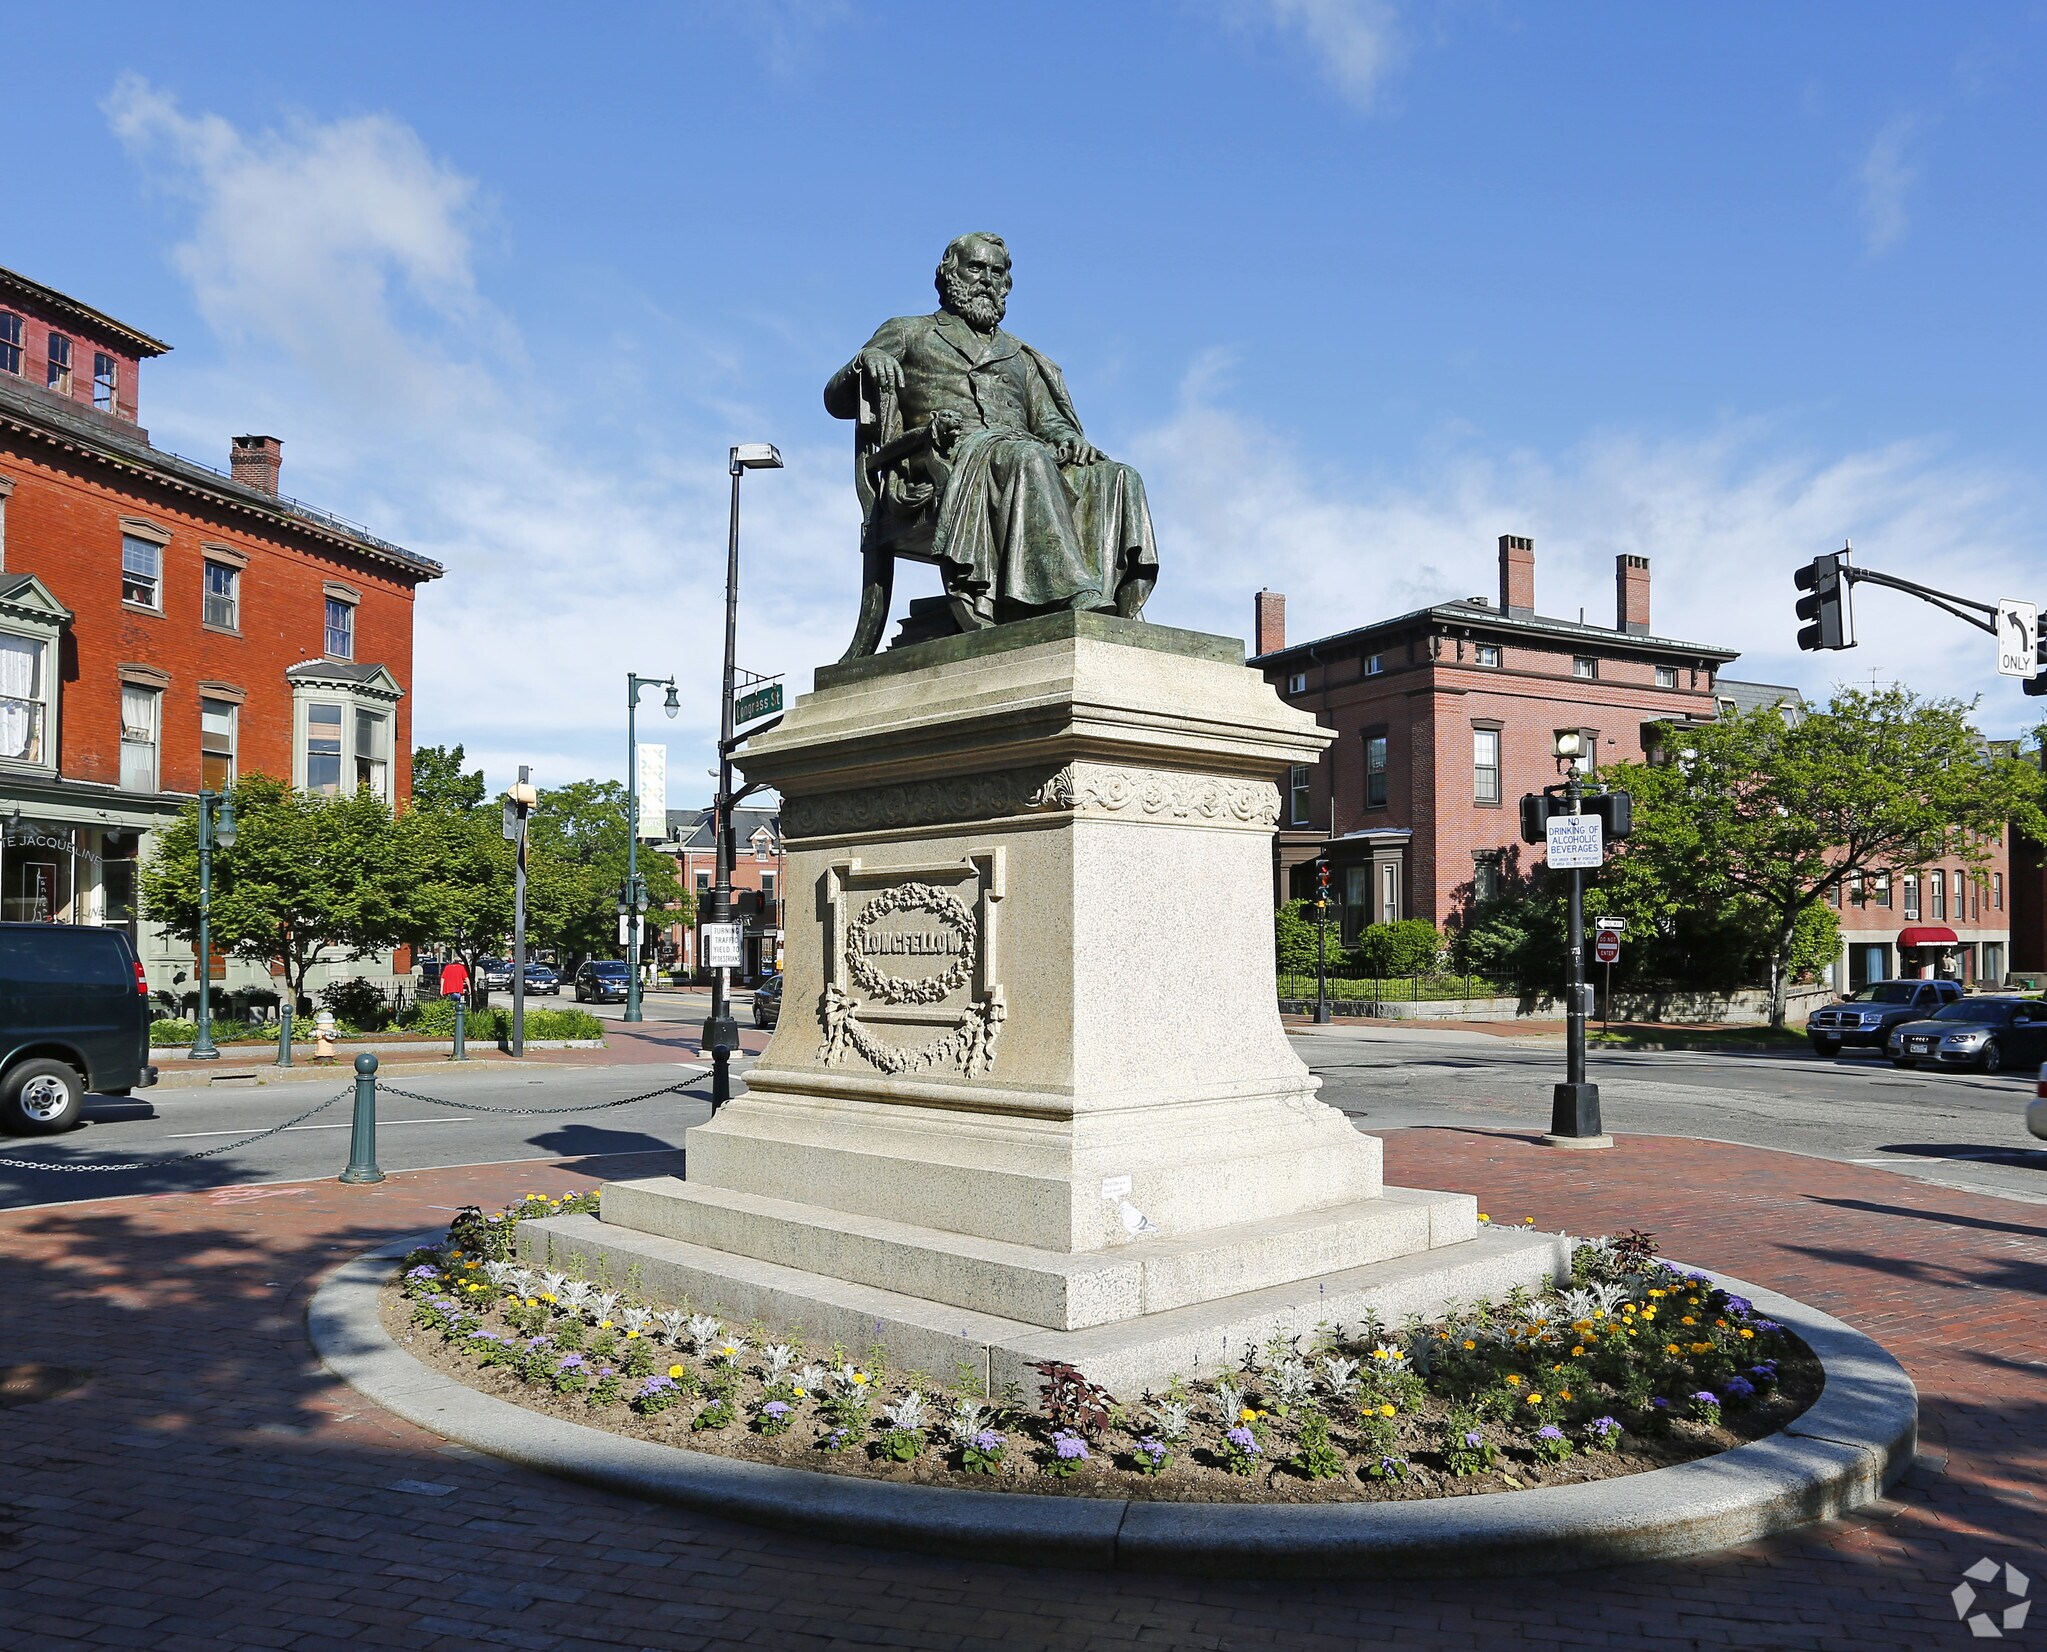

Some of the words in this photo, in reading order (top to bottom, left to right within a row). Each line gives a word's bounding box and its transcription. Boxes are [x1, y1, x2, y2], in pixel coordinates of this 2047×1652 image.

[2003, 654, 2031, 671] ONLY
[736, 698, 769, 719] Congress
[771, 691, 780, 707] St
[1567, 817, 1580, 826] NO
[1549, 826, 1585, 836] DRINKING
[1588, 825, 1599, 834] OF
[1552, 835, 1597, 844] ALCOHOLIC
[20, 835, 103, 867] JACQUELINE
[1551, 844, 1598, 854] BEVERAGES
[863, 931, 962, 955] LONGFELLOW
